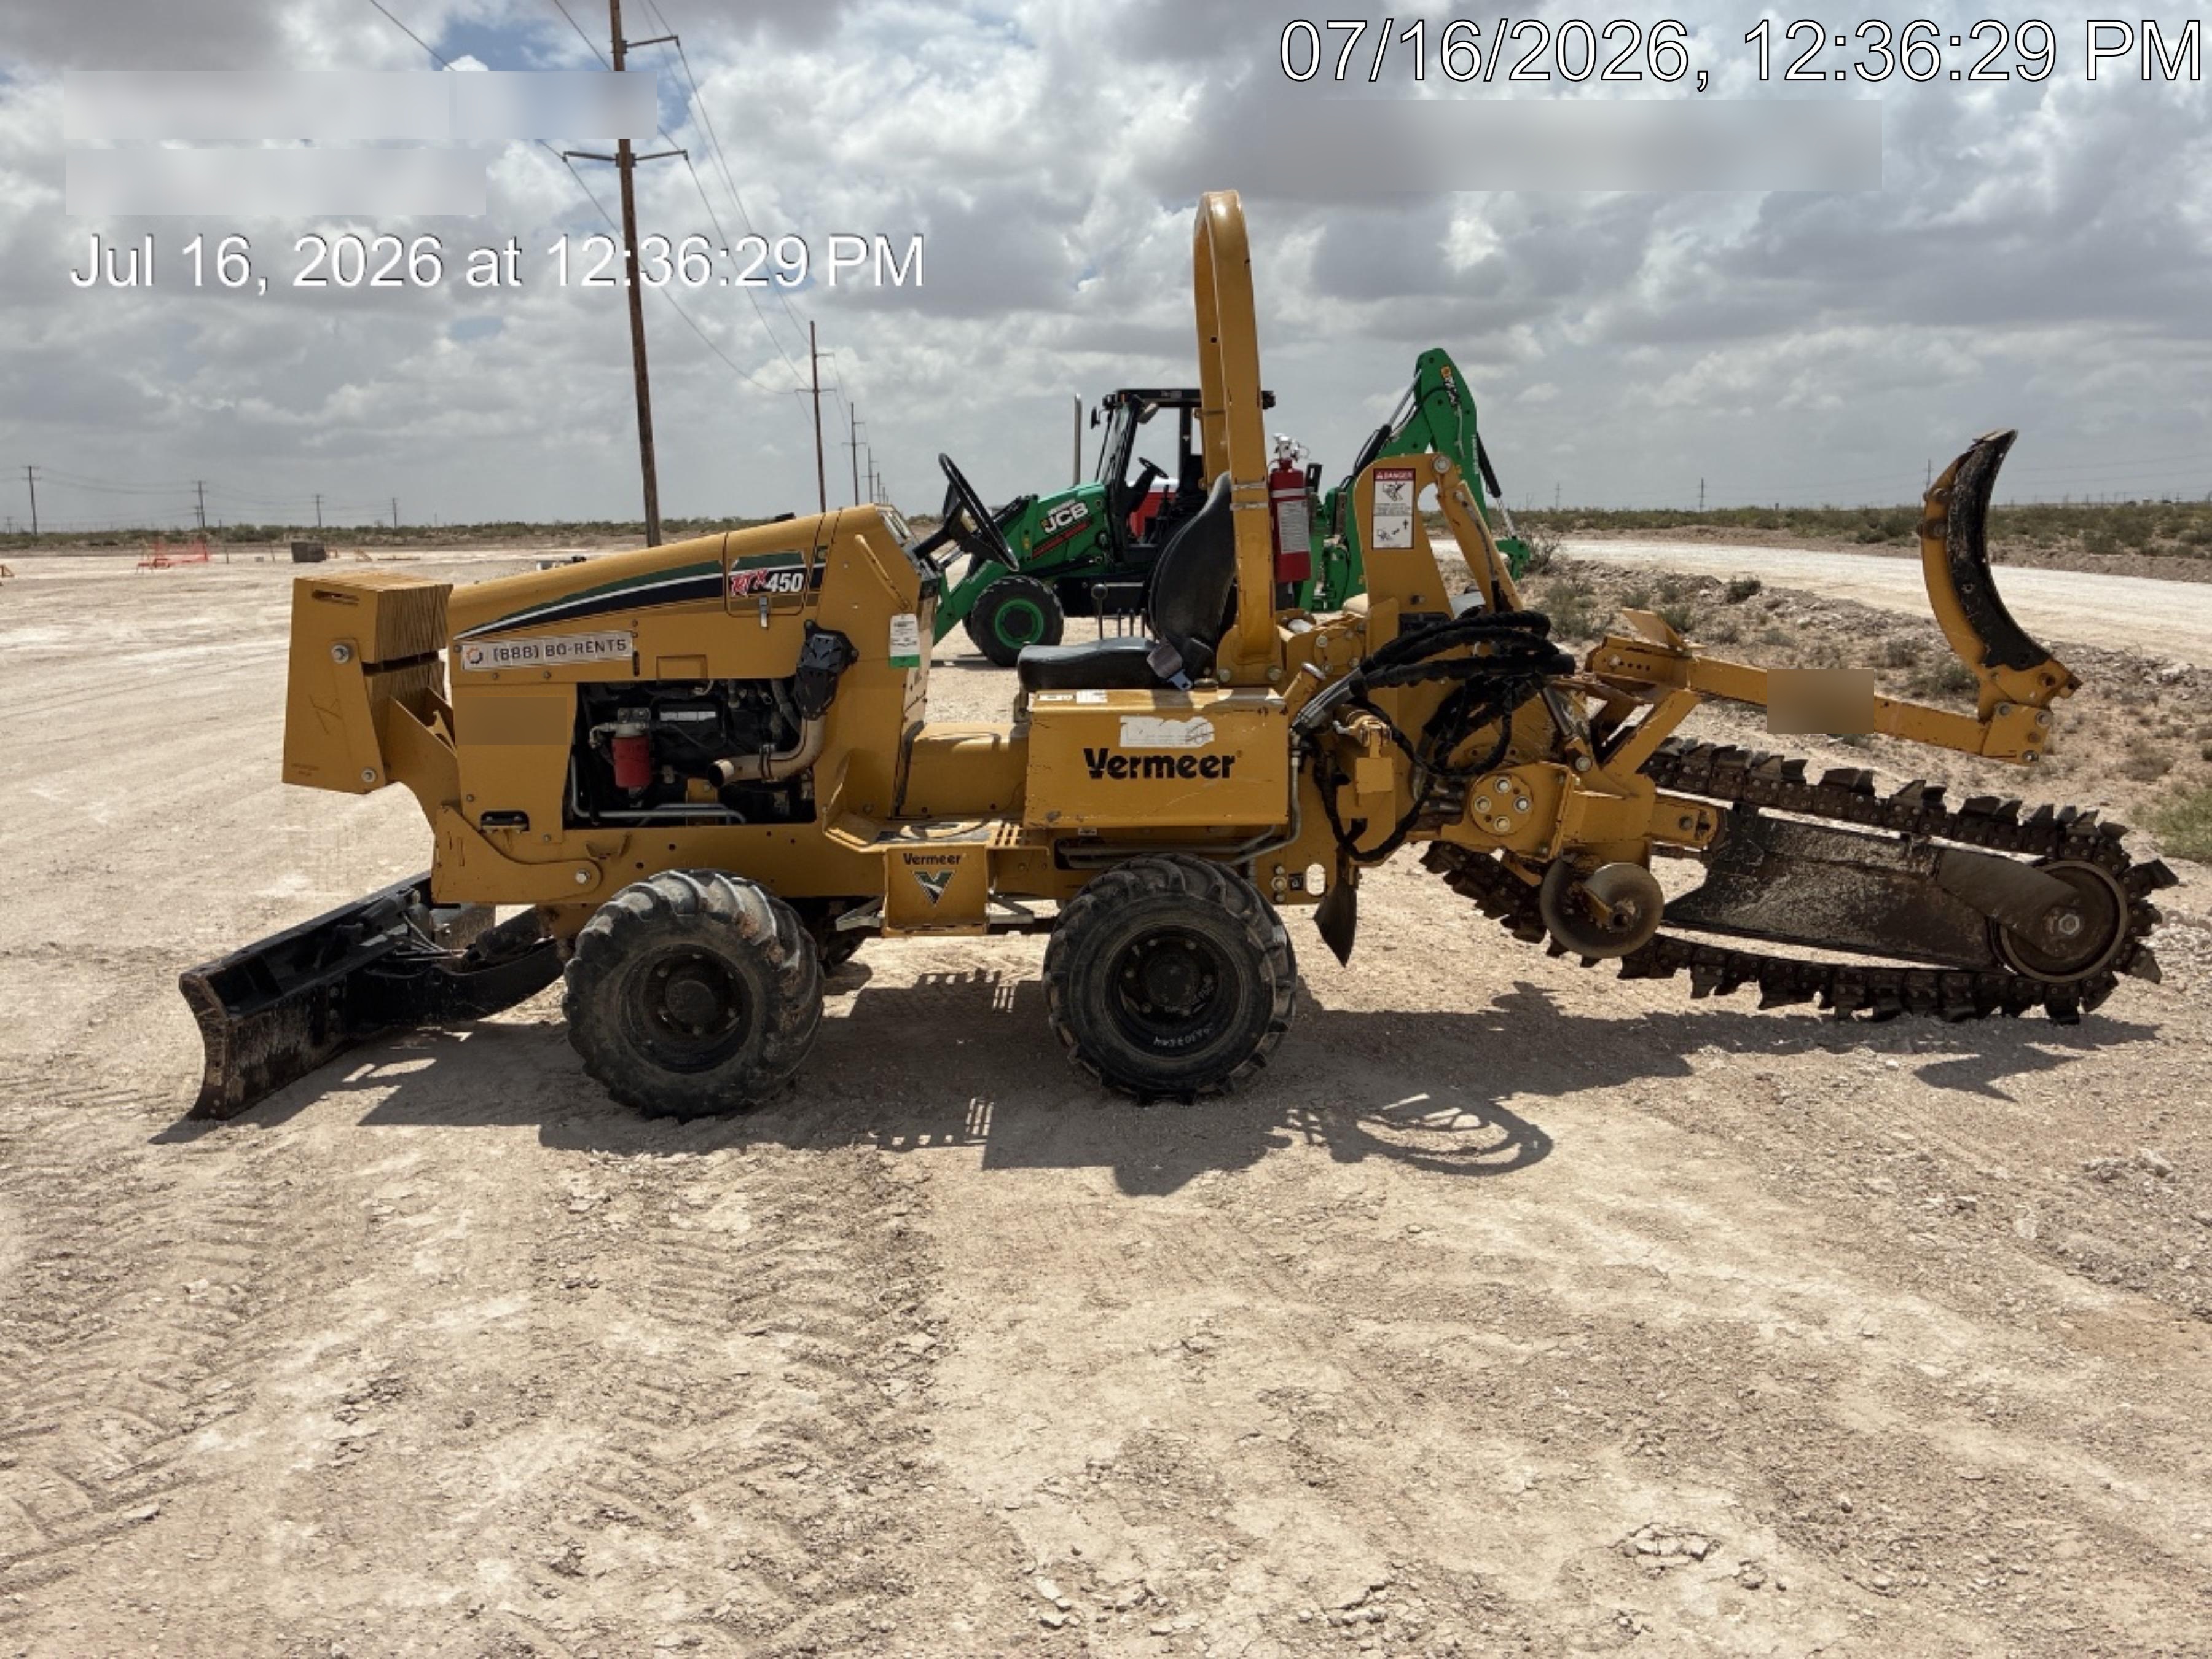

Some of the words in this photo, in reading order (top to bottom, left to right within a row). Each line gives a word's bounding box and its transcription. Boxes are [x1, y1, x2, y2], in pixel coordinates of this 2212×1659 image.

[1045, 502, 1088, 533] JCB
[764, 572, 804, 593] 450
[1083, 748, 1236, 779] Vermeer
[903, 853, 961, 866] Vermeer
